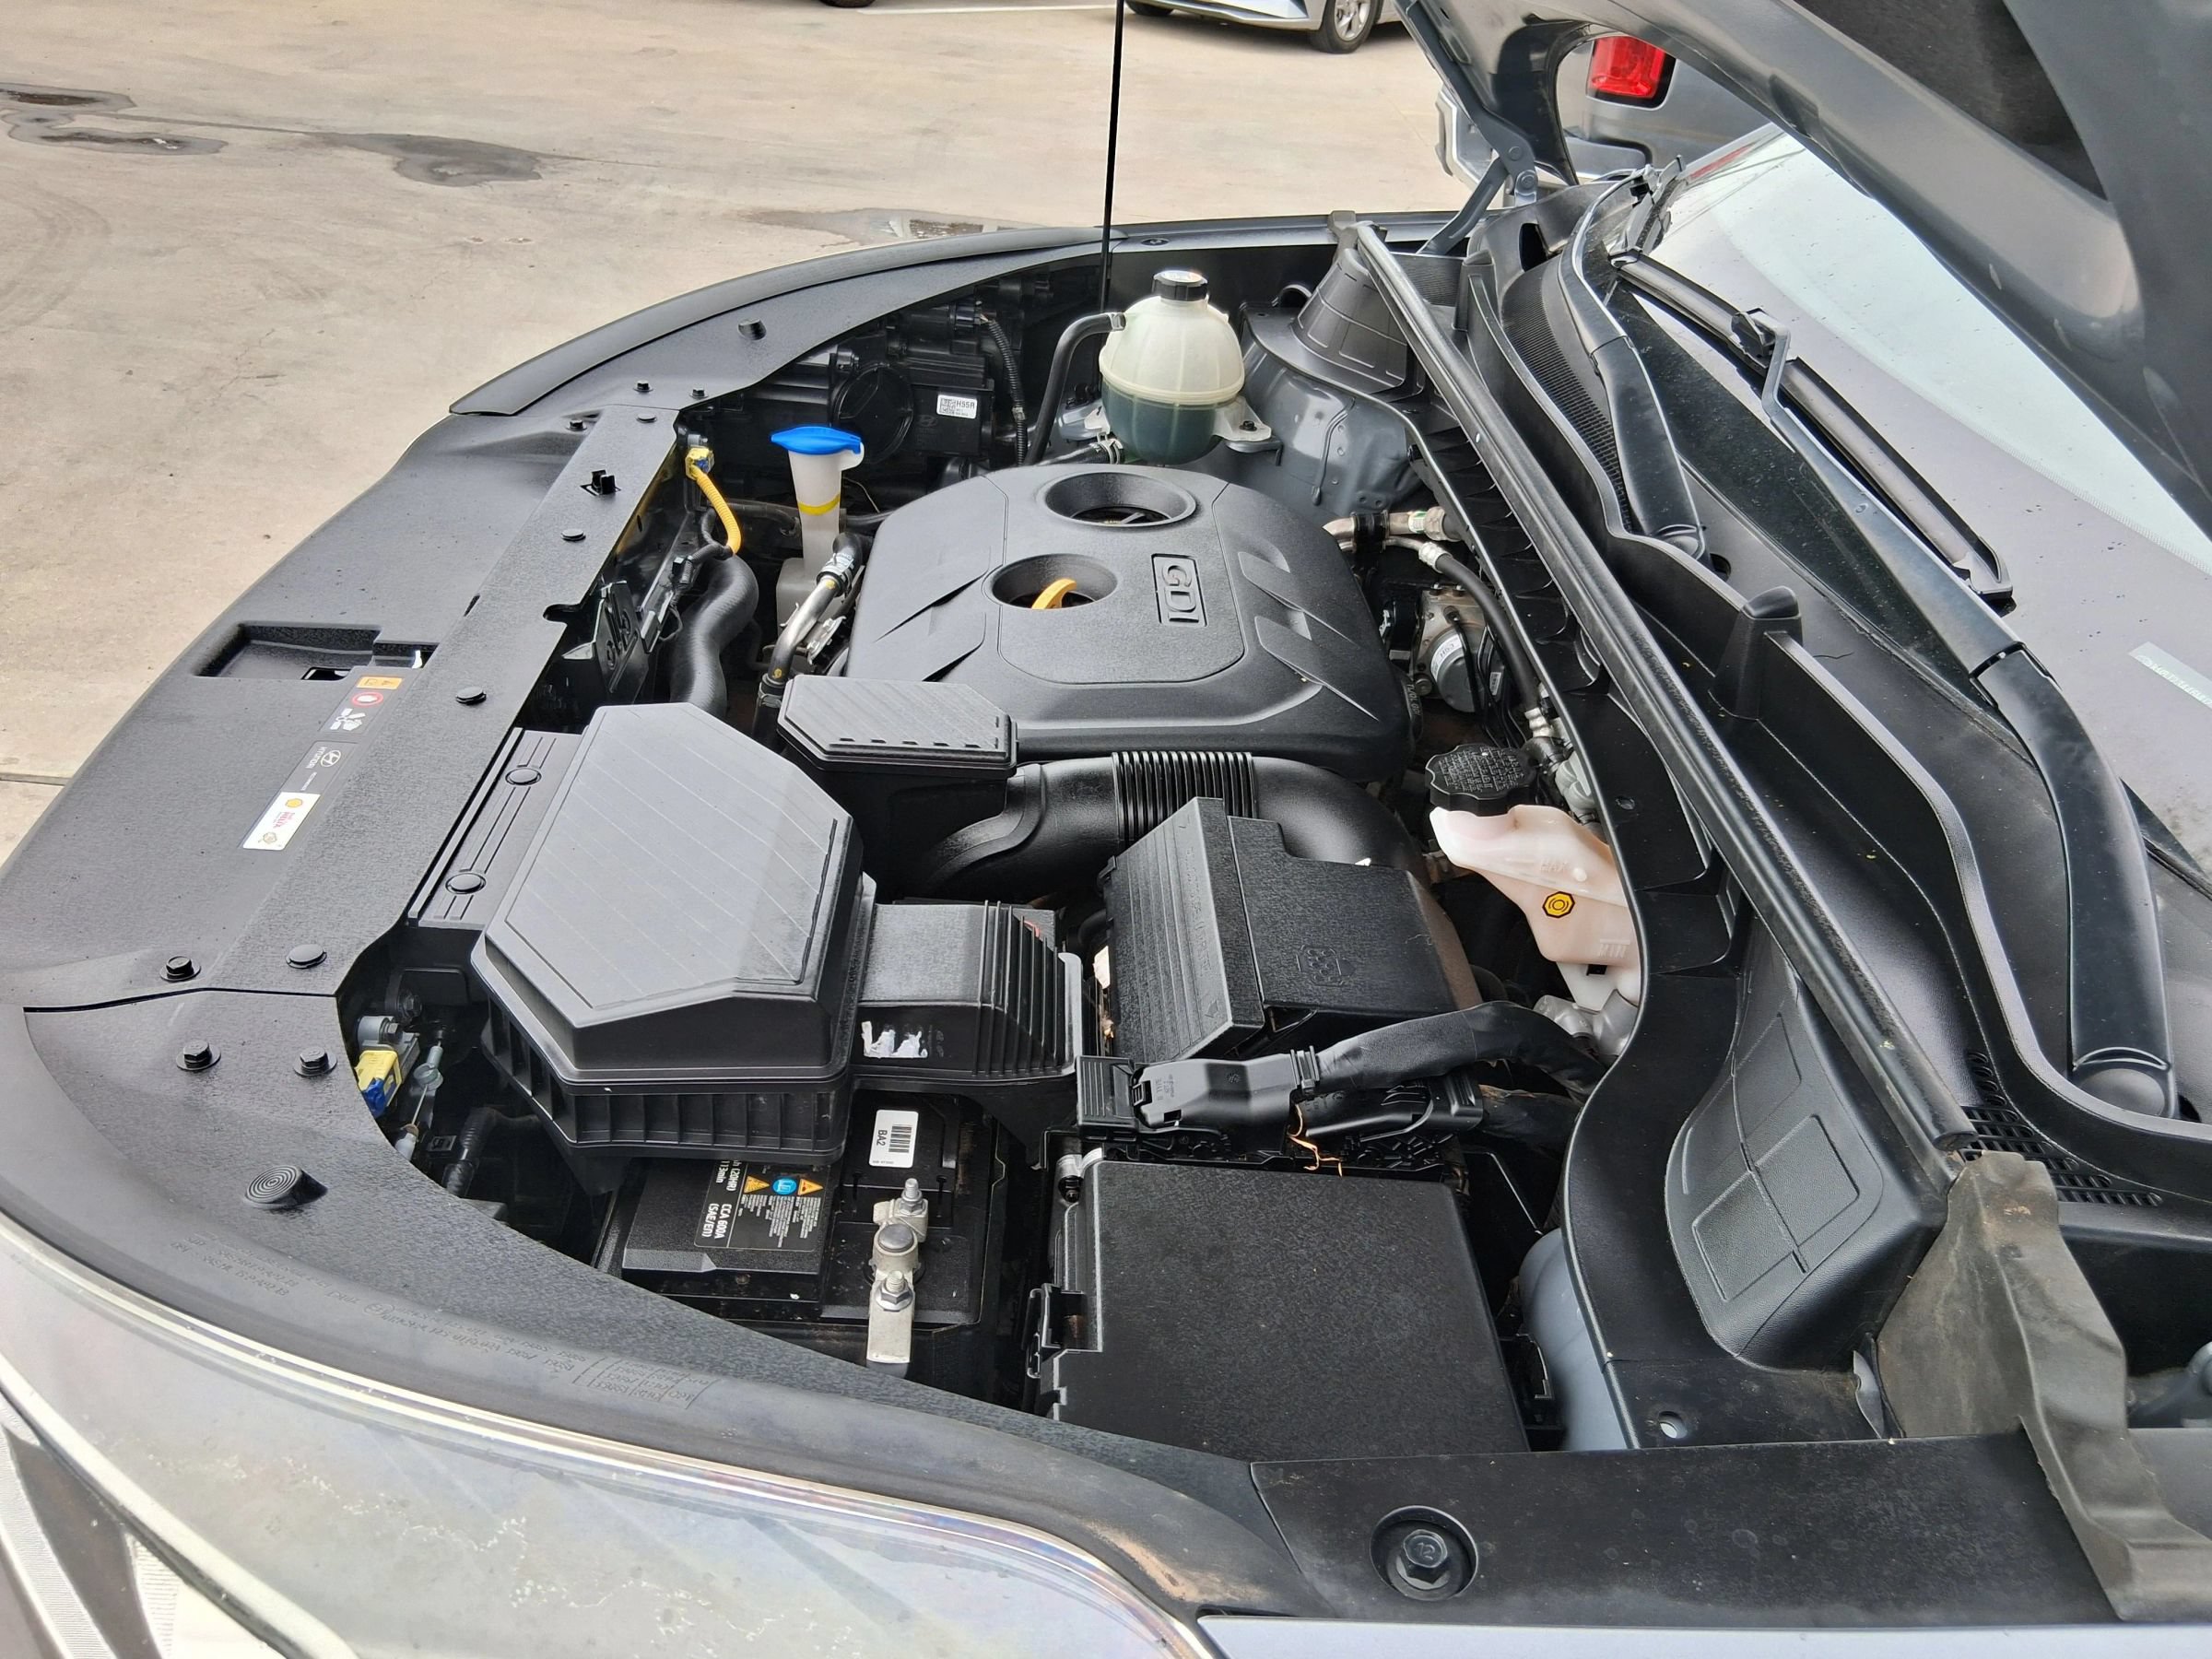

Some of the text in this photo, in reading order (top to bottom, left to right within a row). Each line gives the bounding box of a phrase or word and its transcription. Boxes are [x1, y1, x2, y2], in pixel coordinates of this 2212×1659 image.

[1162, 565, 1200, 624] GDI
[305, 747, 328, 769] HYUNDAI
[876, 1129, 888, 1147] BA2
[726, 1168, 741, 1192] (20HR)
[714, 1203, 733, 1240] CCA 600A
